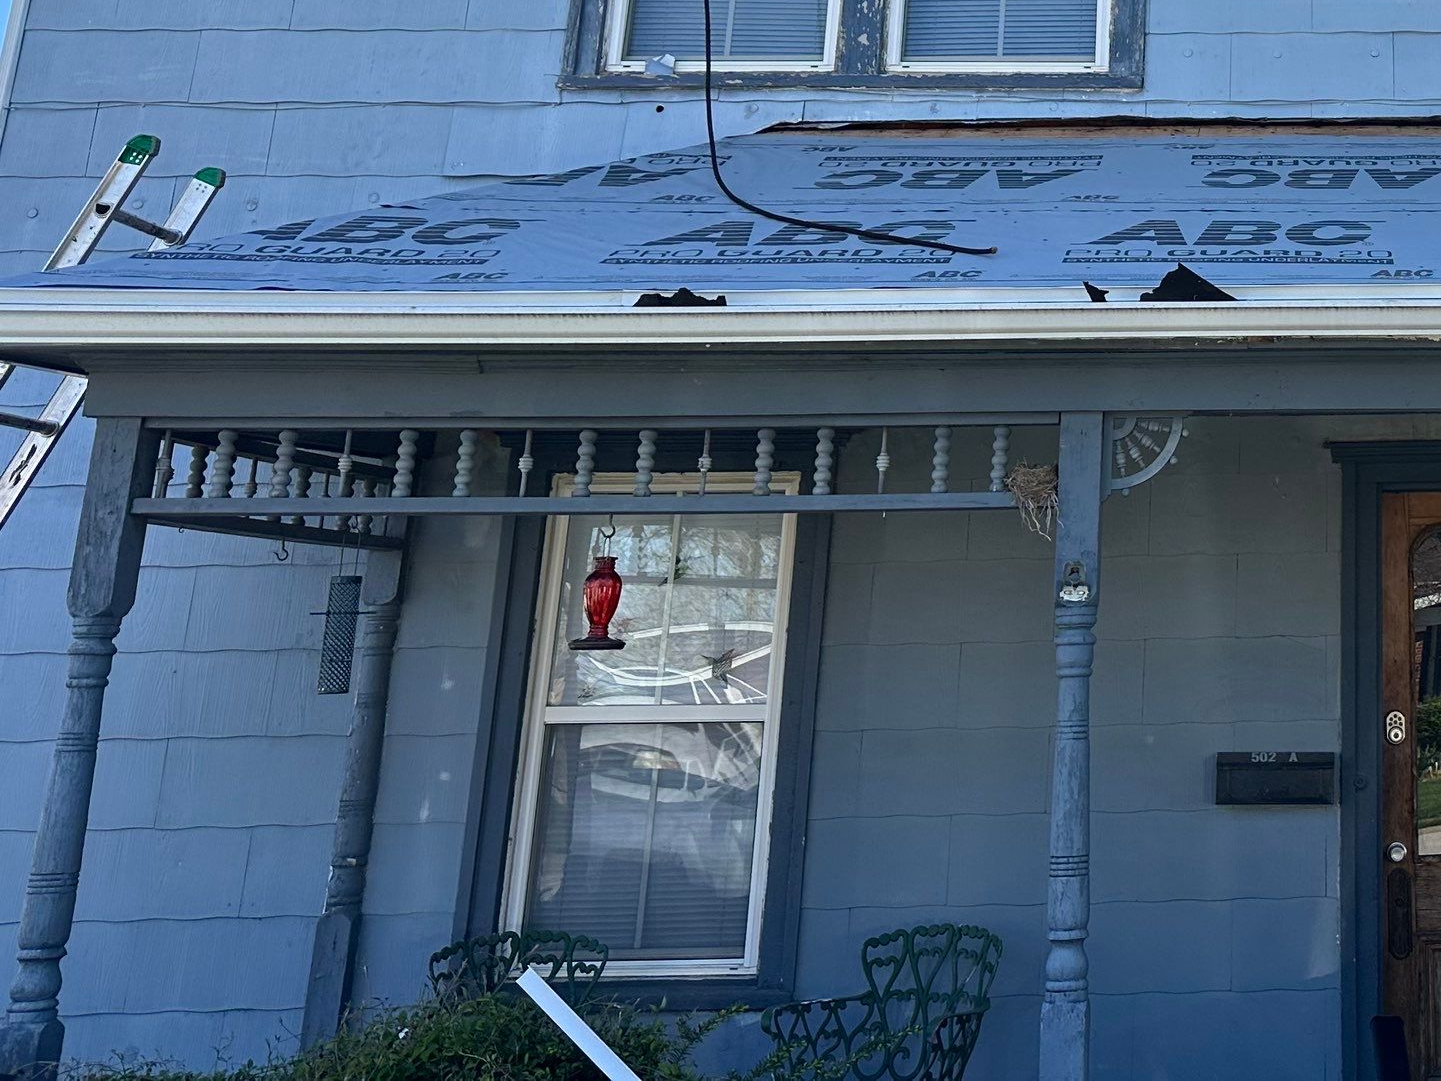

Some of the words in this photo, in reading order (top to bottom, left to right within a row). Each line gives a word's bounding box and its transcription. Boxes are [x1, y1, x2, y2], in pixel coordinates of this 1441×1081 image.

[793, 169, 1097, 189] ABC
[624, 220, 976, 246] ABC
[1070, 219, 1386, 246] ABC
[176, 243, 244, 253] RO
[255, 245, 426, 258] GUARD
[438, 249, 501, 258] 20
[609, 249, 704, 257] PRO
[717, 249, 882, 257] GUARD
[898, 249, 958, 257] 20
[1065, 249, 1152, 257] PRO
[1167, 249, 1323, 257] GUARD
[1339, 250, 1393, 258] 20
[433, 272, 509, 280] ABC
[914, 270, 983, 278] ABC
[1369, 269, 1434, 277] ABC
[1251, 752, 1277, 762] 502
[1288, 752, 1298, 762] A
